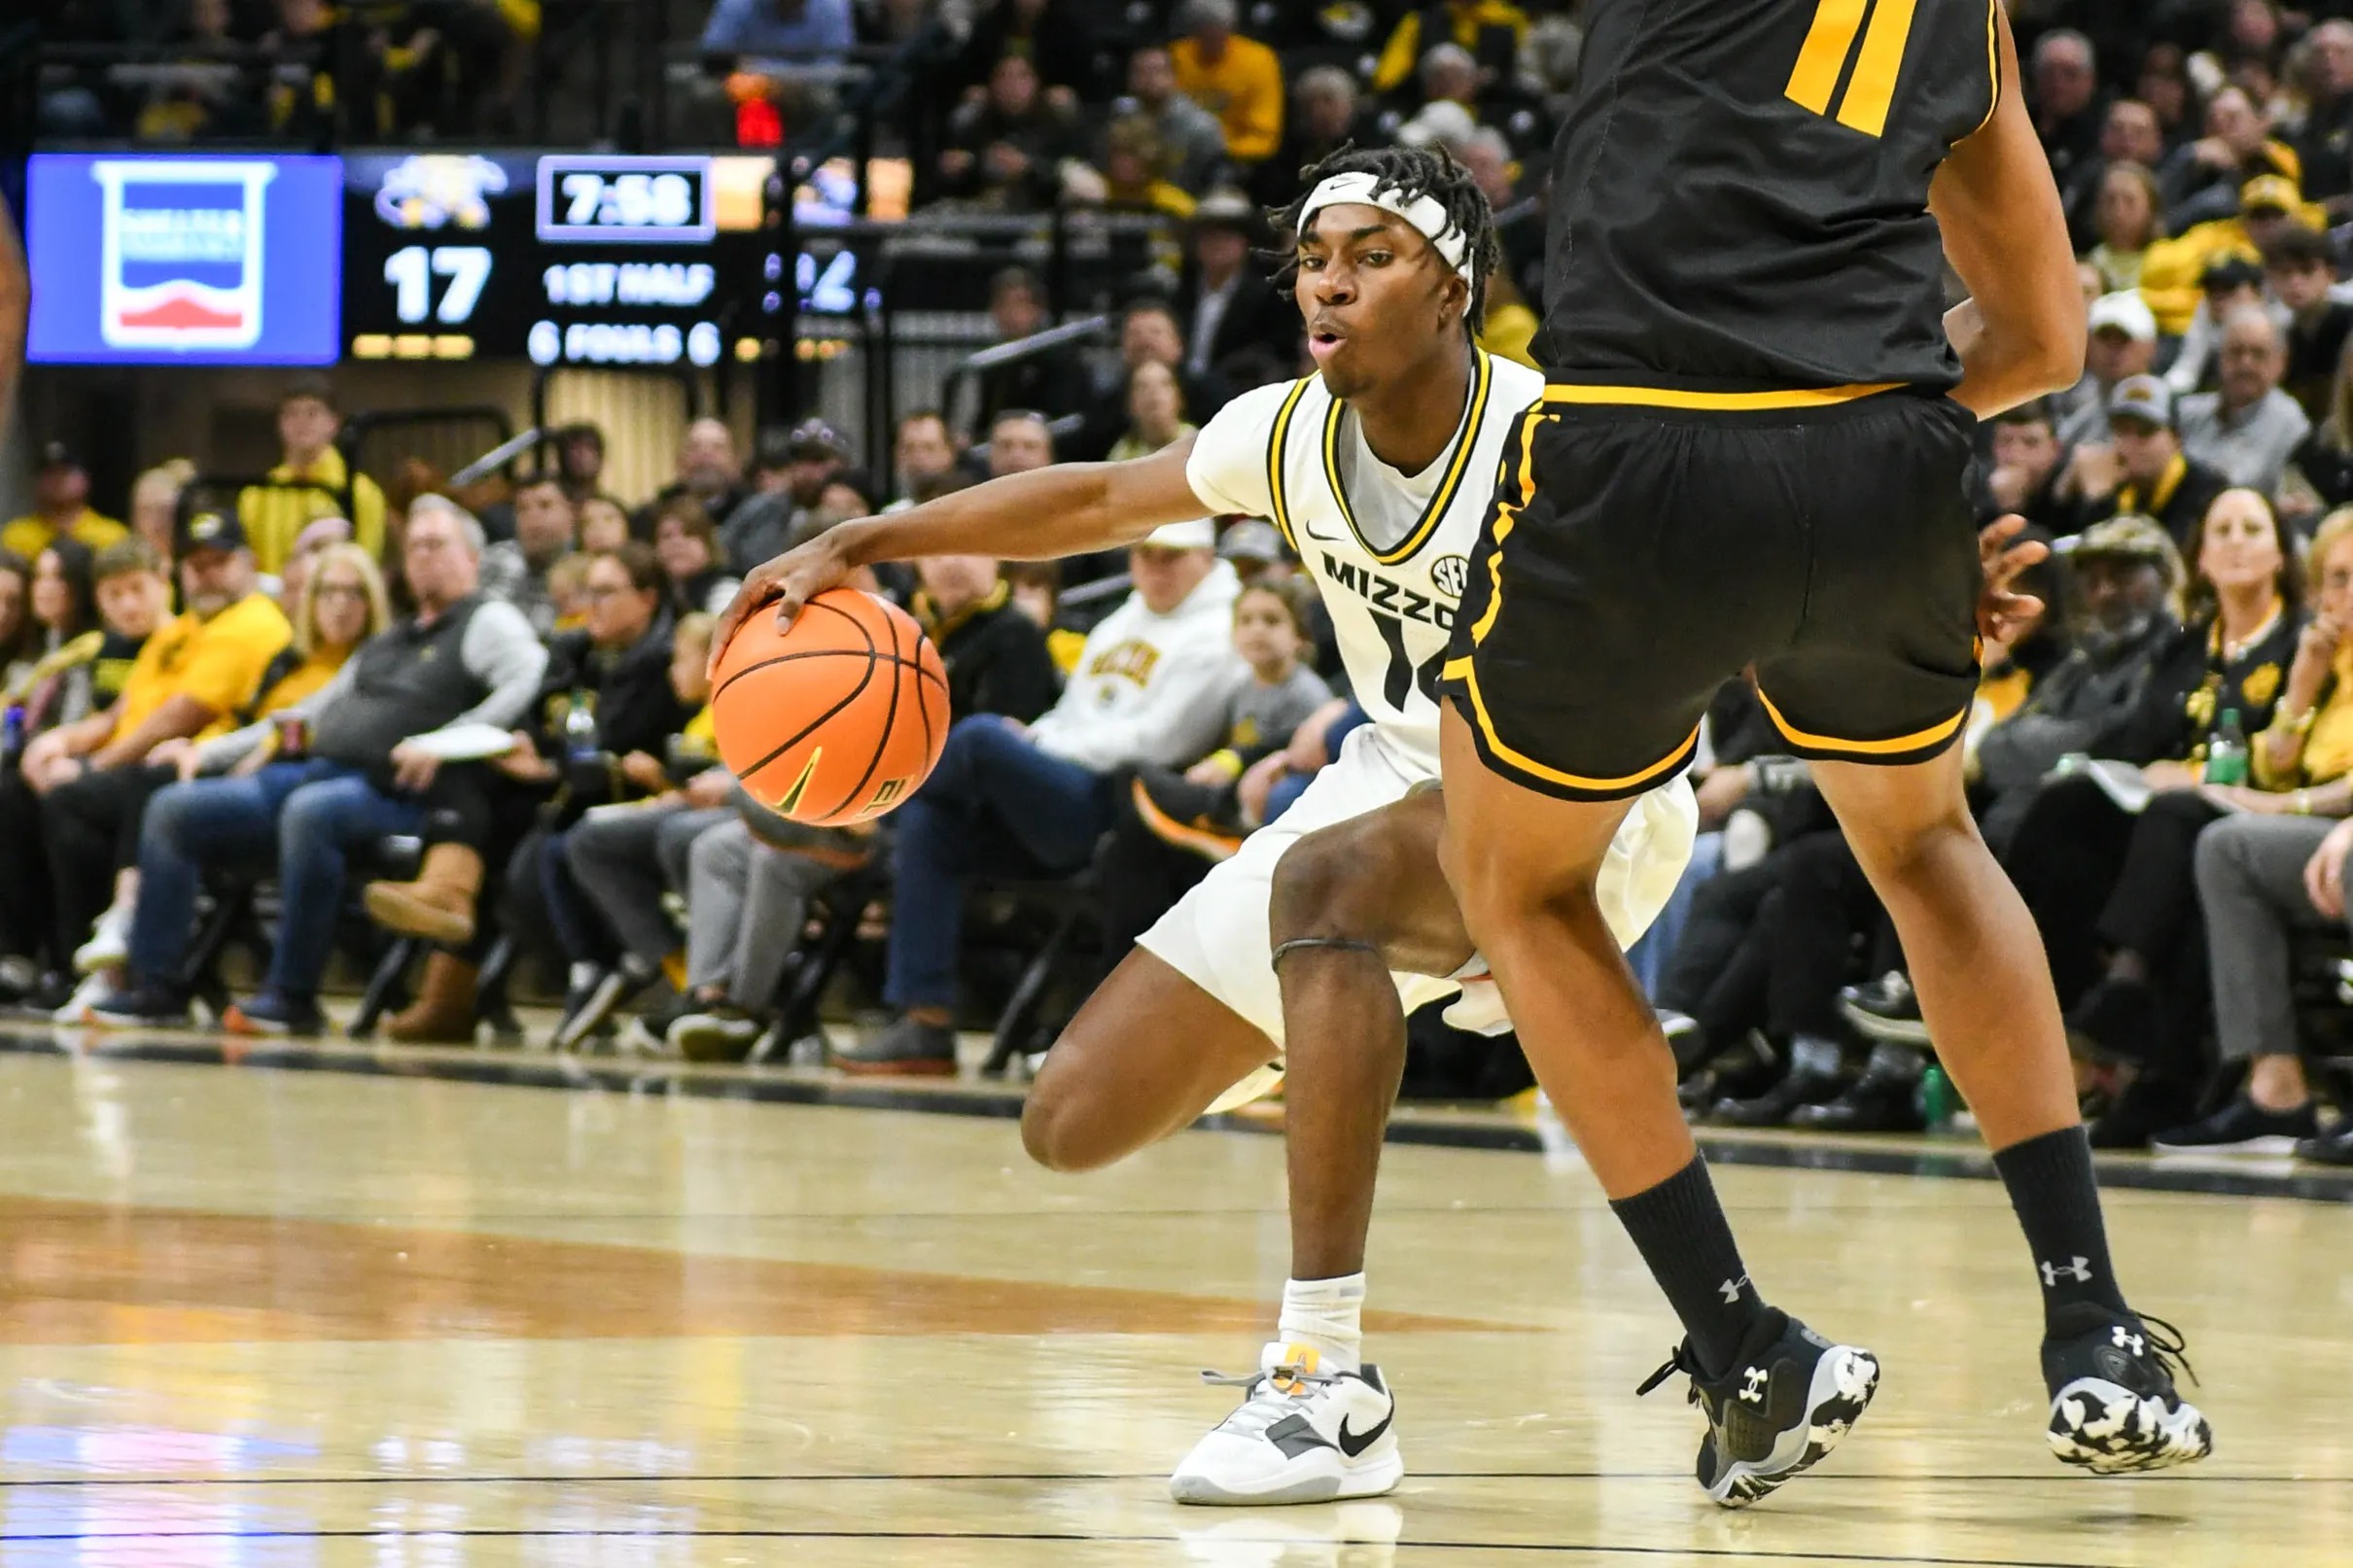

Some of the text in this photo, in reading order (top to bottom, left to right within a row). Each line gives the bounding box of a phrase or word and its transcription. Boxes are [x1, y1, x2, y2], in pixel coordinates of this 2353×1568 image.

[384, 246, 492, 323] 17
[543, 262, 616, 306] 1ST
[616, 262, 716, 306] HALF
[565, 323, 683, 365] FOULS
